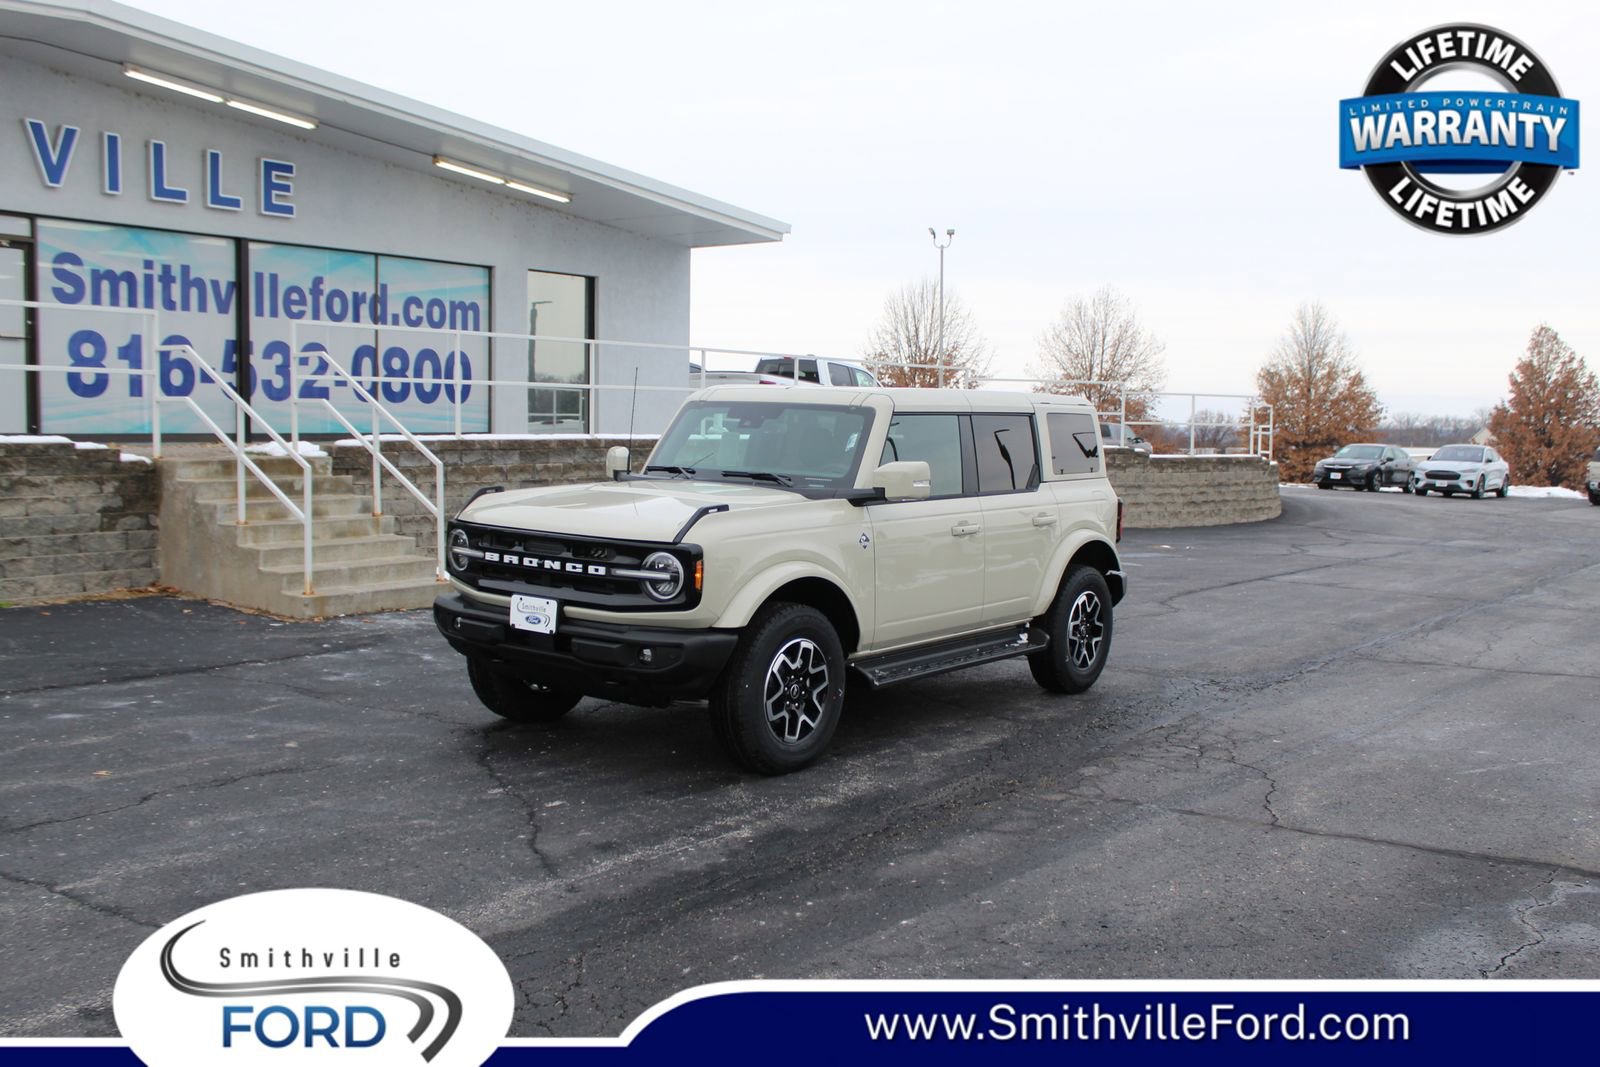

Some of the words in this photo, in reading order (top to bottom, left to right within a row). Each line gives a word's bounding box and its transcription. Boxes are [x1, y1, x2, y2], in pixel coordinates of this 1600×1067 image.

[25, 118, 296, 217] VILLE
[51, 252, 480, 331] Smithvlleford.com
[485, 552, 606, 575] BRONCO
